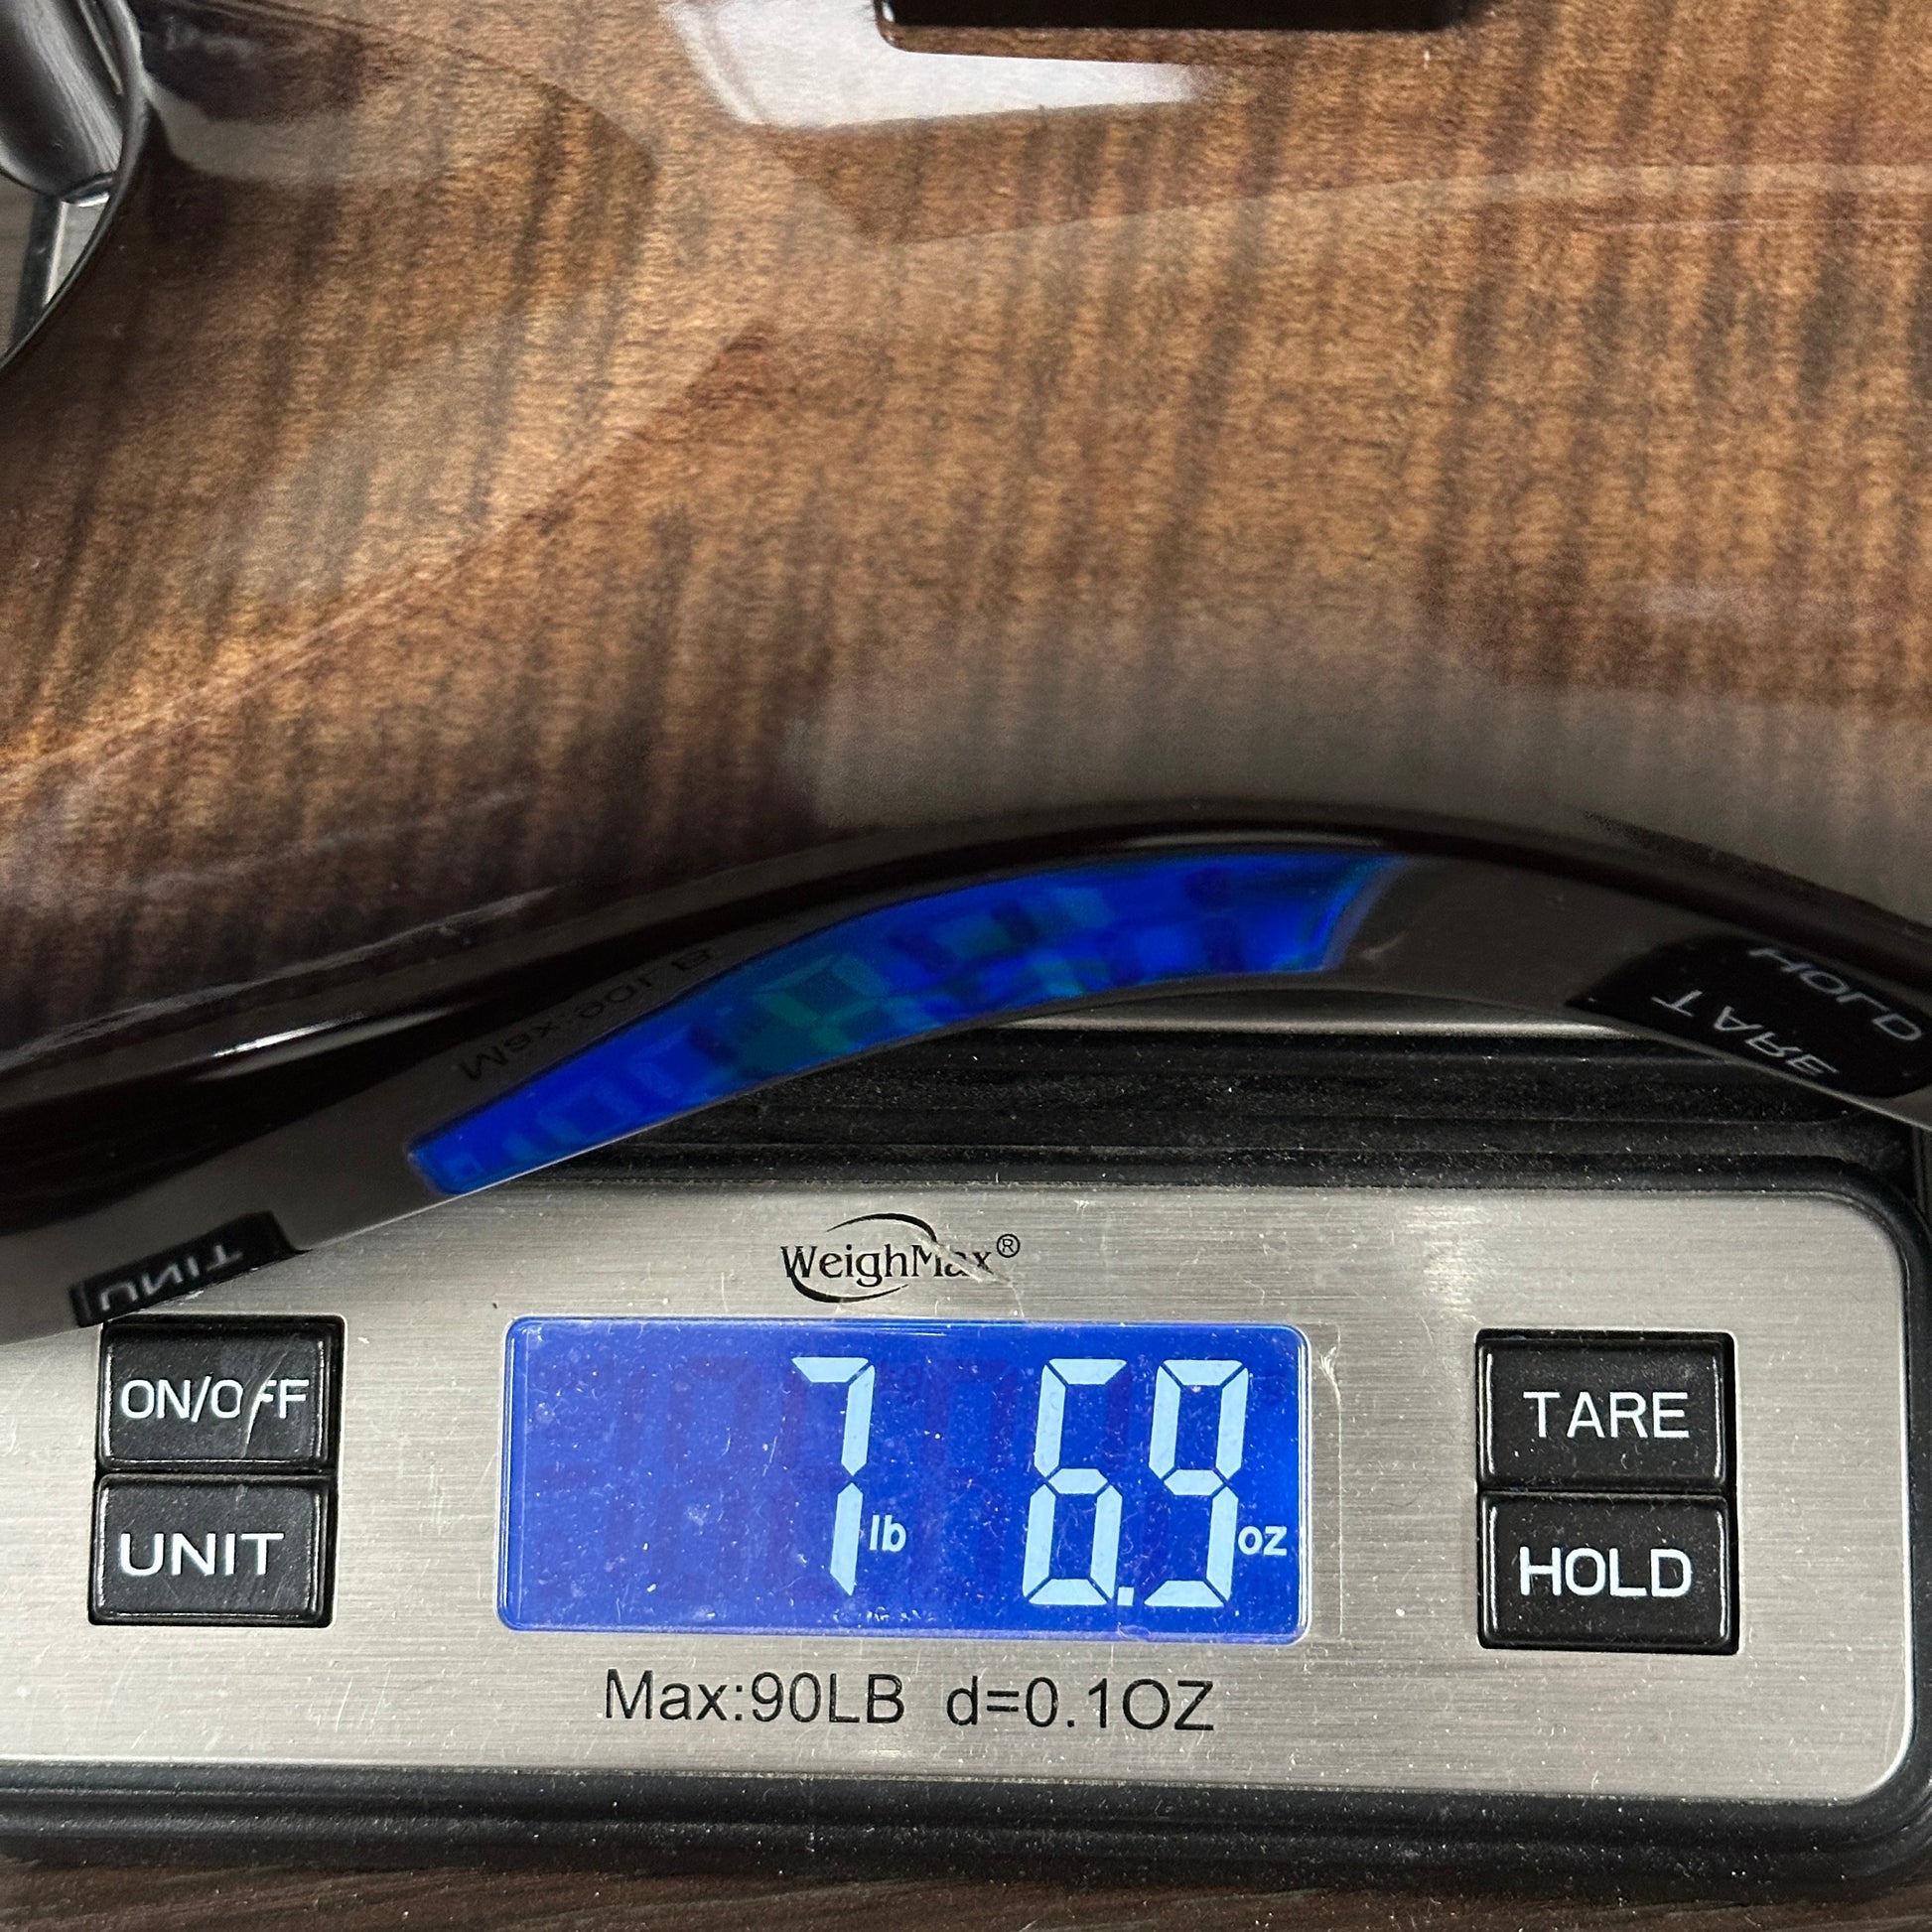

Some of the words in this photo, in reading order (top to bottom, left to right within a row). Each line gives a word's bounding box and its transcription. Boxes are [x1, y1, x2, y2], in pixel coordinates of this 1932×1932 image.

[1522, 1391, 1690, 1439] TARE
[792, 1356, 876, 1596] 7
[869, 1514, 907, 1553] lb
[1023, 1357, 1249, 1608] 6.9
[1237, 1524, 1289, 1556] oz
[119, 1533, 285, 1577] UNIT
[1519, 1546, 1694, 1597] HOLD
[605, 1669, 904, 1725] Max:90LB
